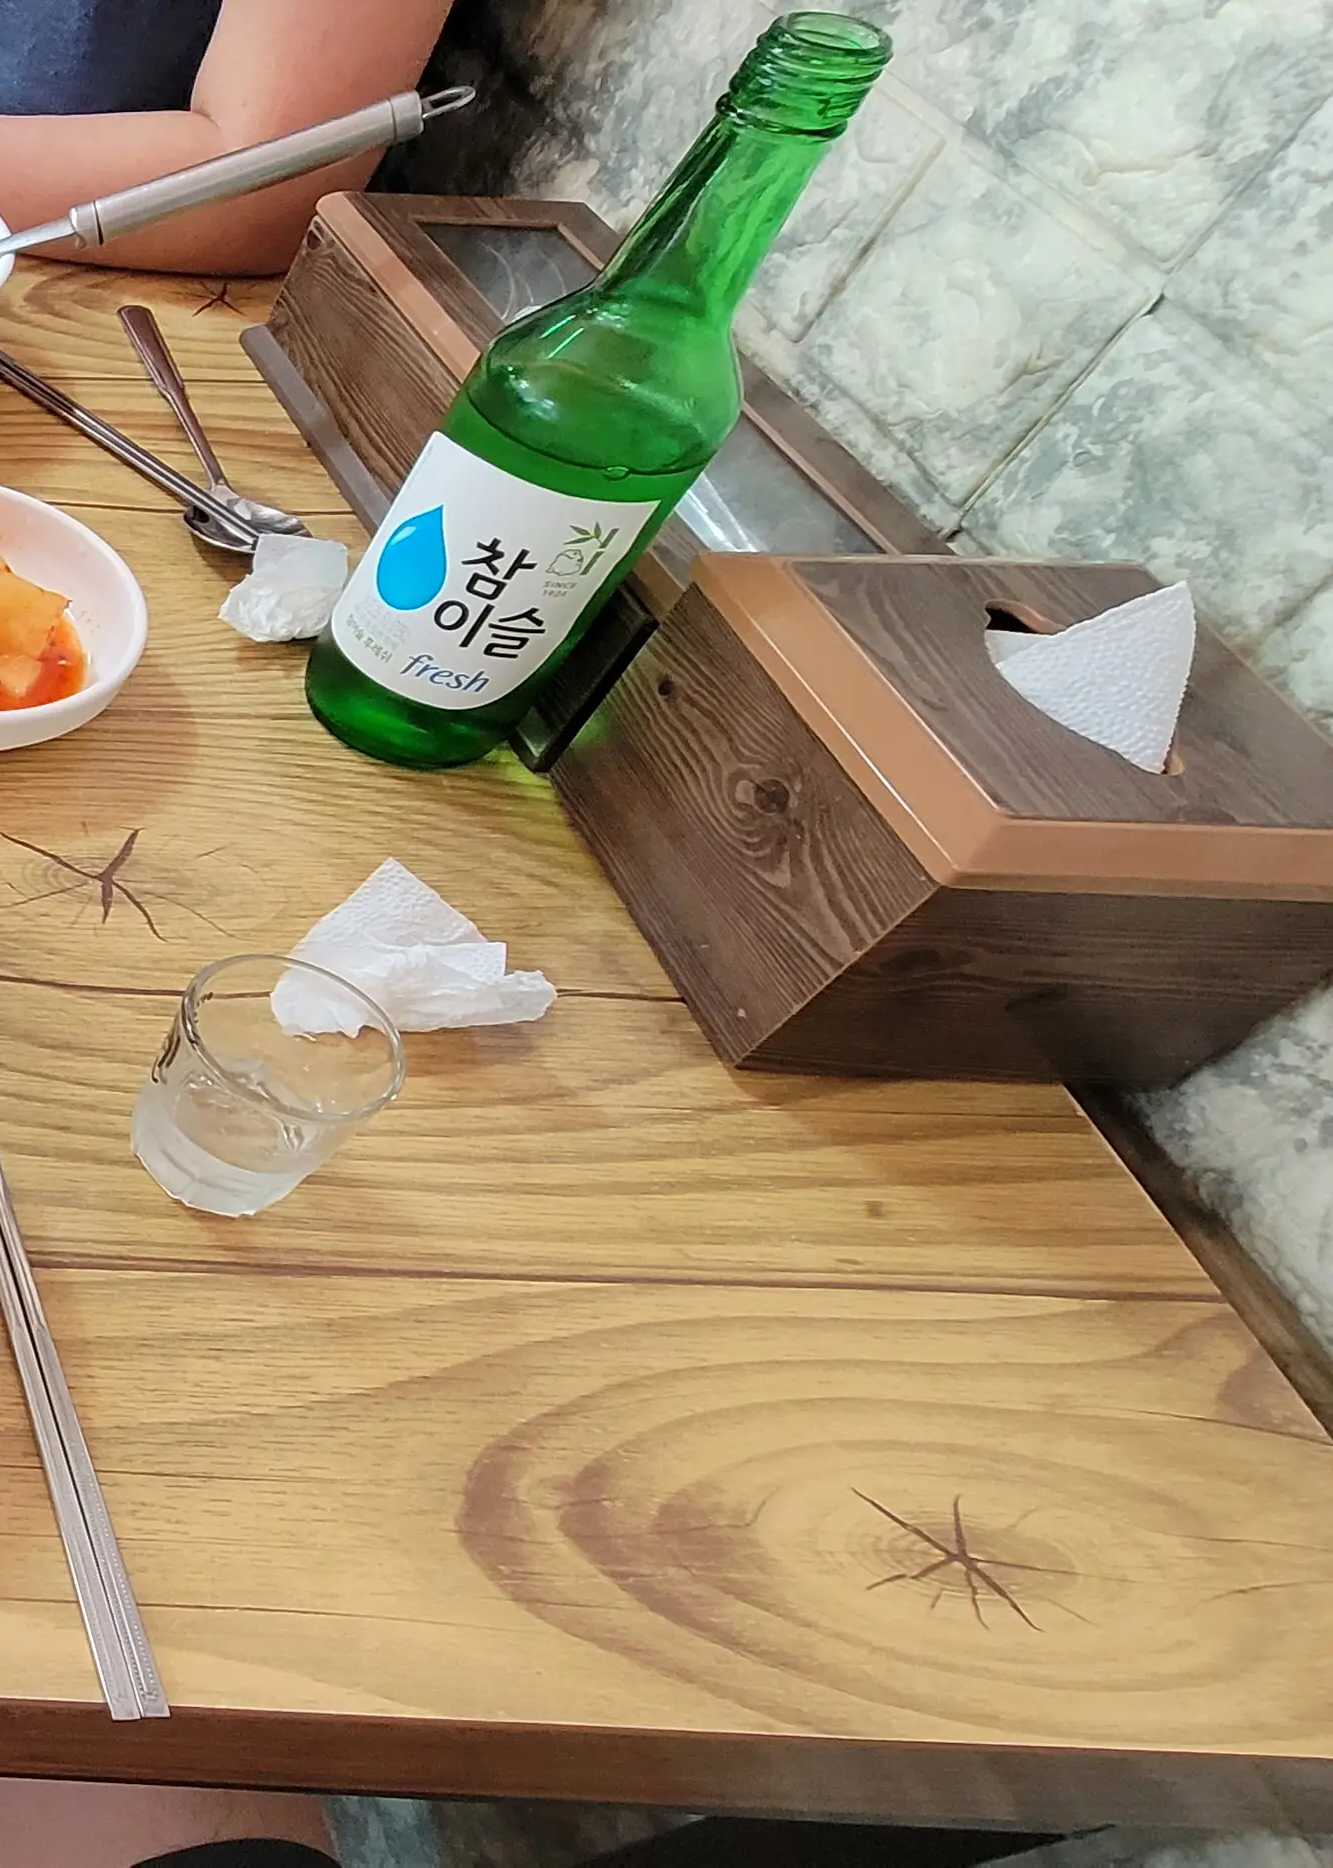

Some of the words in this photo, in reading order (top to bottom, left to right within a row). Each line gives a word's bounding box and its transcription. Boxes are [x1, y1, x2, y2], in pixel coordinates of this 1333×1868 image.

[461, 537, 538, 601] 참
[543, 580, 578, 590] SINCE
[433, 600, 546, 659] 이슬
[399, 654, 490, 693] fresh
